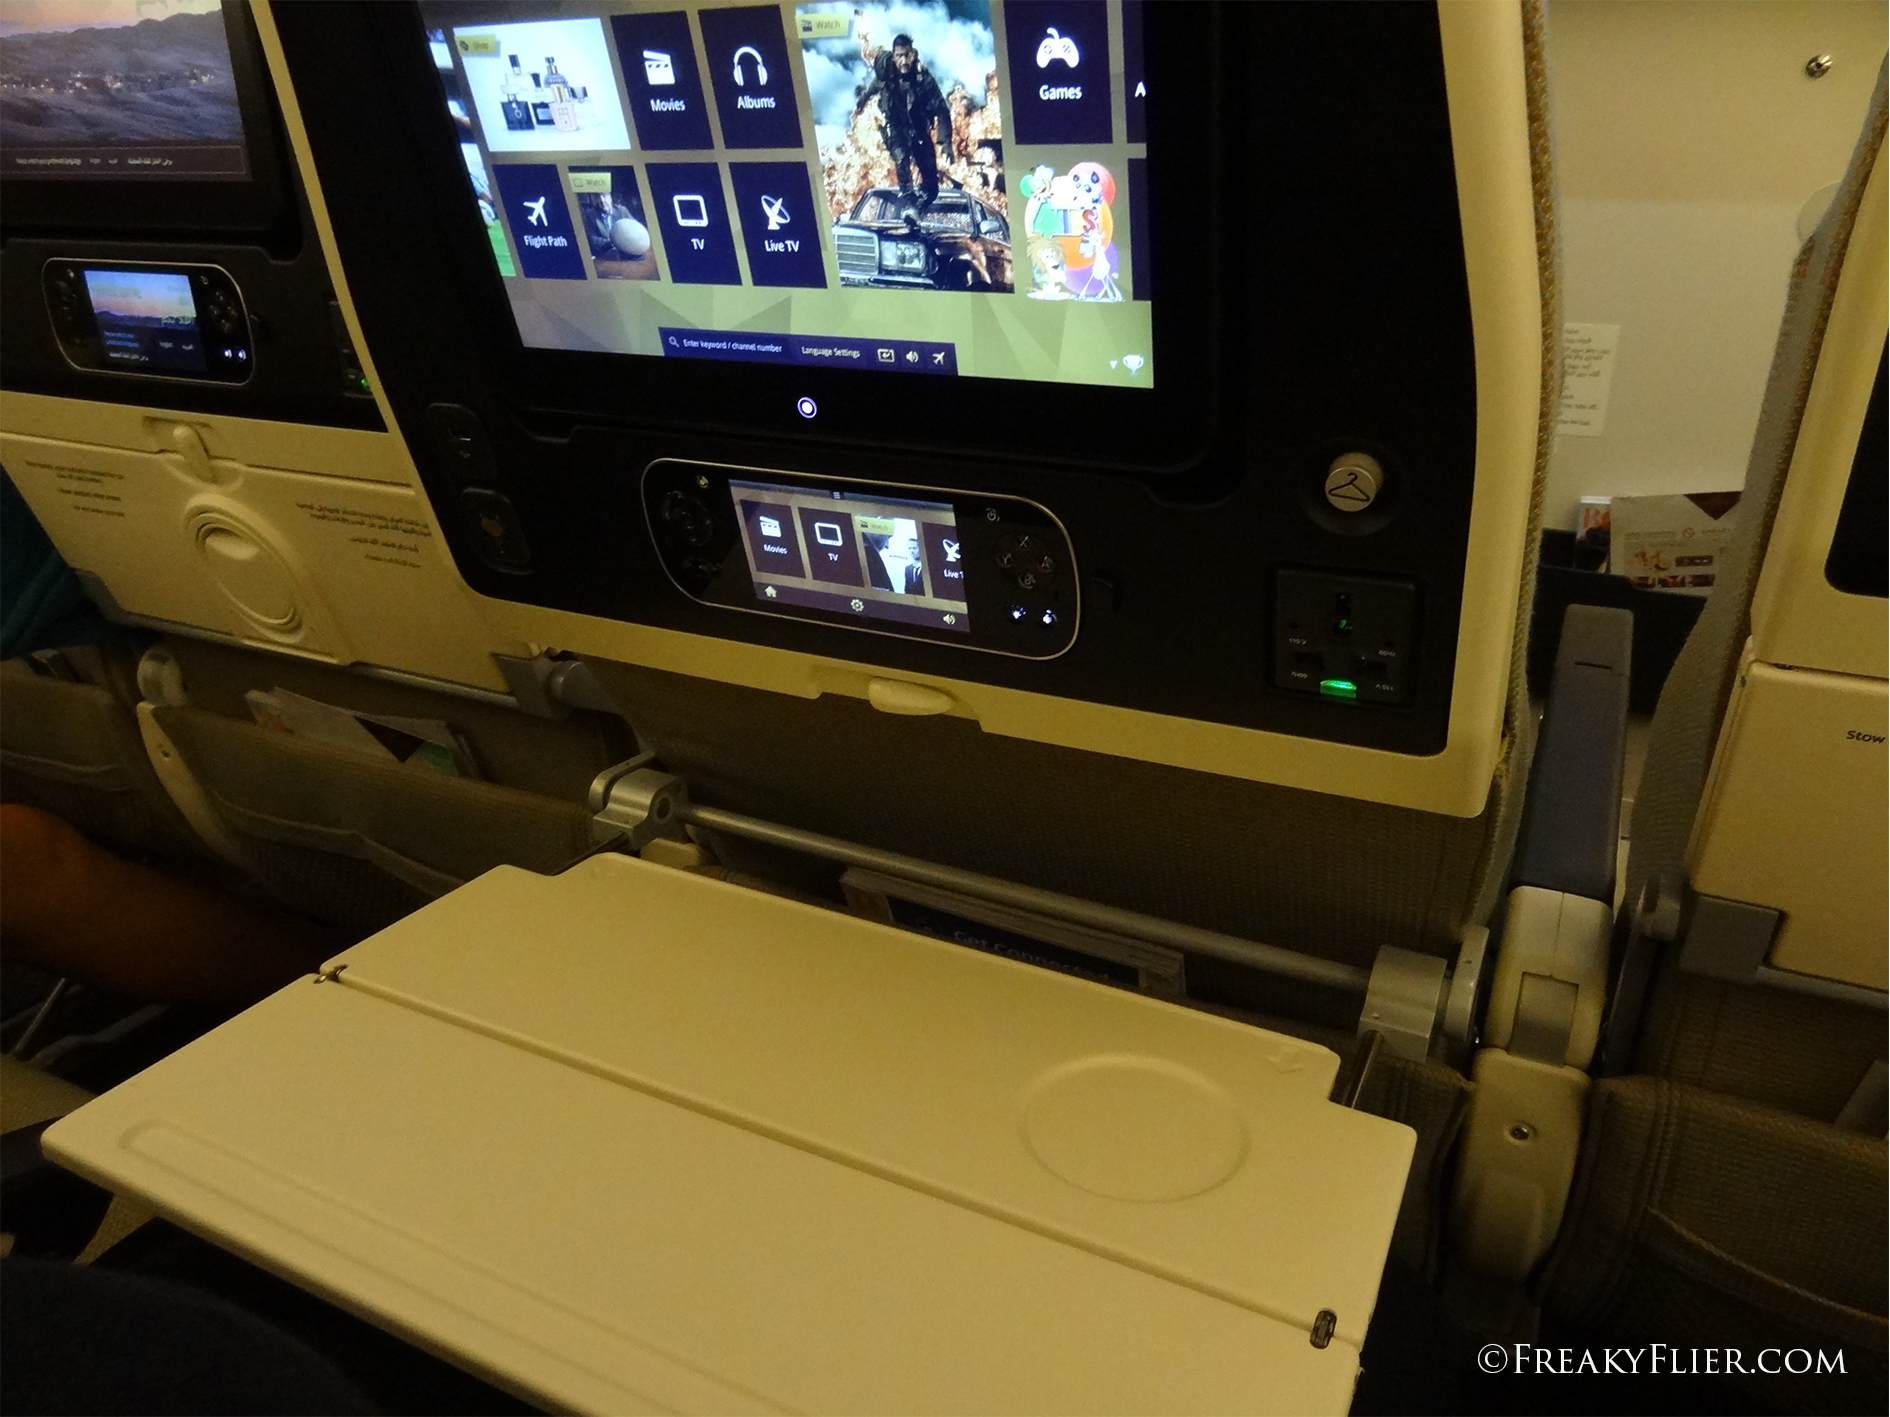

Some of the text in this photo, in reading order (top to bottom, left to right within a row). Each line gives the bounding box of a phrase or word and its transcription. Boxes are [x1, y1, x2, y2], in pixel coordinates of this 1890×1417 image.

[814, 19, 841, 30] Watch
[1039, 83, 1083, 101] Games
[650, 99, 686, 113] Movies
[737, 95, 776, 110] Albums
[524, 235, 568, 248] Flight Path
[691, 239, 705, 250] TV
[764, 239, 800, 252] Live TV
[682, 338, 699, 348] Enter
[700, 339, 727, 350] keyword
[731, 341, 756, 351] channel
[757, 343, 783, 353] number
[801, 345, 861, 359] Language Settings
[763, 543, 788, 555] Movies
[827, 552, 839, 561] TV
[943, 568, 958, 579] Live
[1846, 730, 1886, 744] Stow
